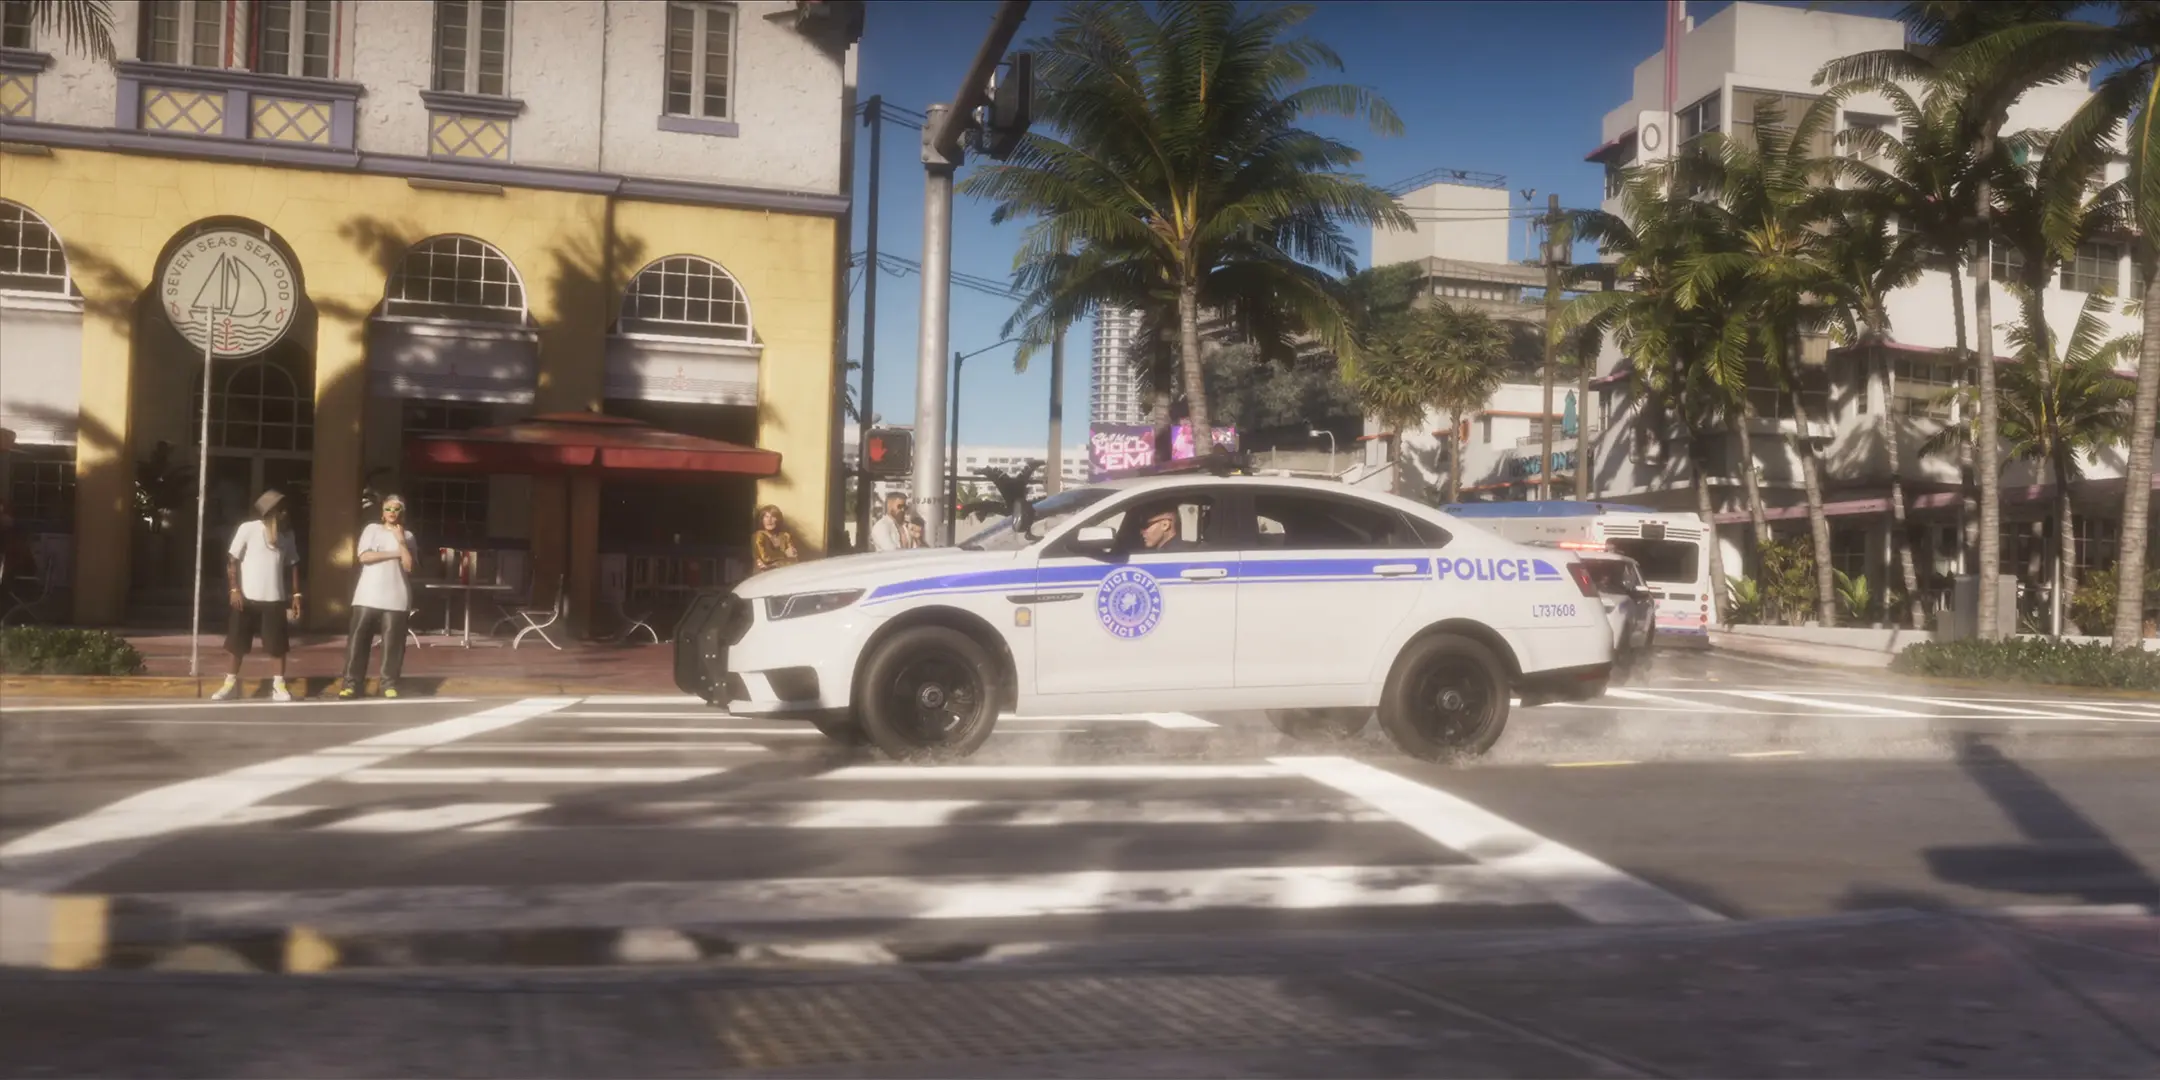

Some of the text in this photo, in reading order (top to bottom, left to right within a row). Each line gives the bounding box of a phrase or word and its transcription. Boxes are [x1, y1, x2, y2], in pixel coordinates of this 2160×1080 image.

[166, 236, 290, 301] SEVEN SEAS SEAFOOD
[1094, 439, 1150, 455] HOLD
[1436, 557, 1530, 582] POLICE
[1103, 572, 1158, 593] VICE CITY
[1099, 606, 1160, 637] POLICE DEPT
[1532, 603, 1576, 618] L737608
